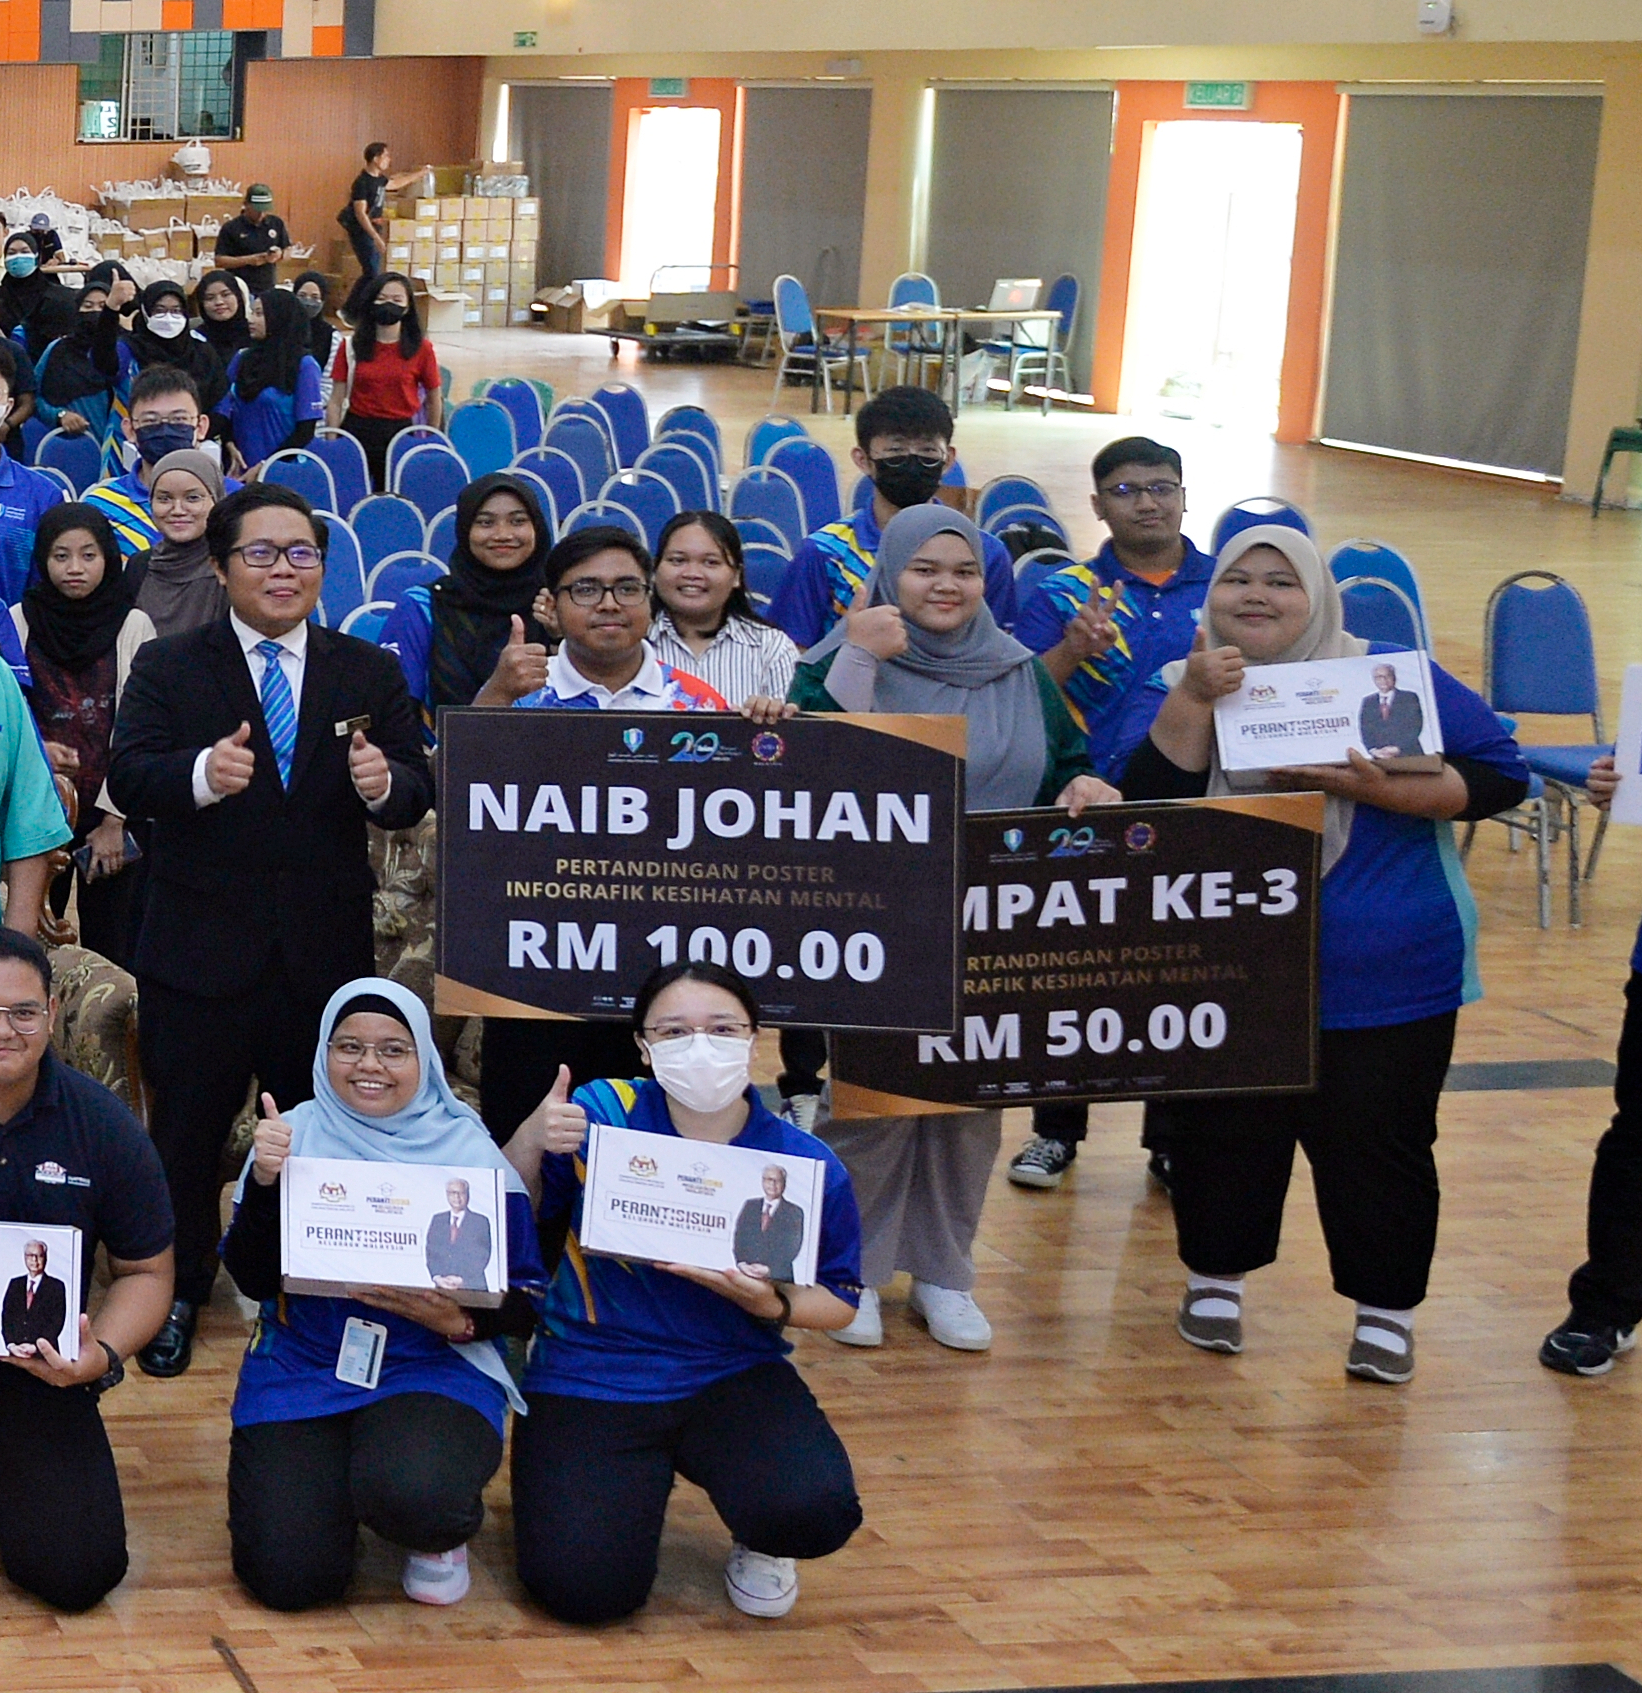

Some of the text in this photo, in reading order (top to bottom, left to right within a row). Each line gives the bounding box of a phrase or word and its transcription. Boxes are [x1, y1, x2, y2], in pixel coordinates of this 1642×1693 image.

[1241, 716, 1351, 736] PERANTISISWA
[467, 782, 932, 851] NAIB JOHAN
[555, 858, 836, 884] PERTANDINGAN POSTER
[505, 880, 886, 910] INFOGRAFIK KESIHATAN MENTAL
[962, 867, 1299, 932] MPAT KE-3
[507, 919, 886, 983] RM 100.00
[966, 944, 1202, 972] RTANDINGAN POSTER
[963, 964, 1248, 995] RAFIK KESIHATAN MENTAL
[918, 1001, 1227, 1065] RM 50.00
[611, 1198, 727, 1230] PERANTISISWA
[306, 1226, 418, 1245] PERANTISISWA
